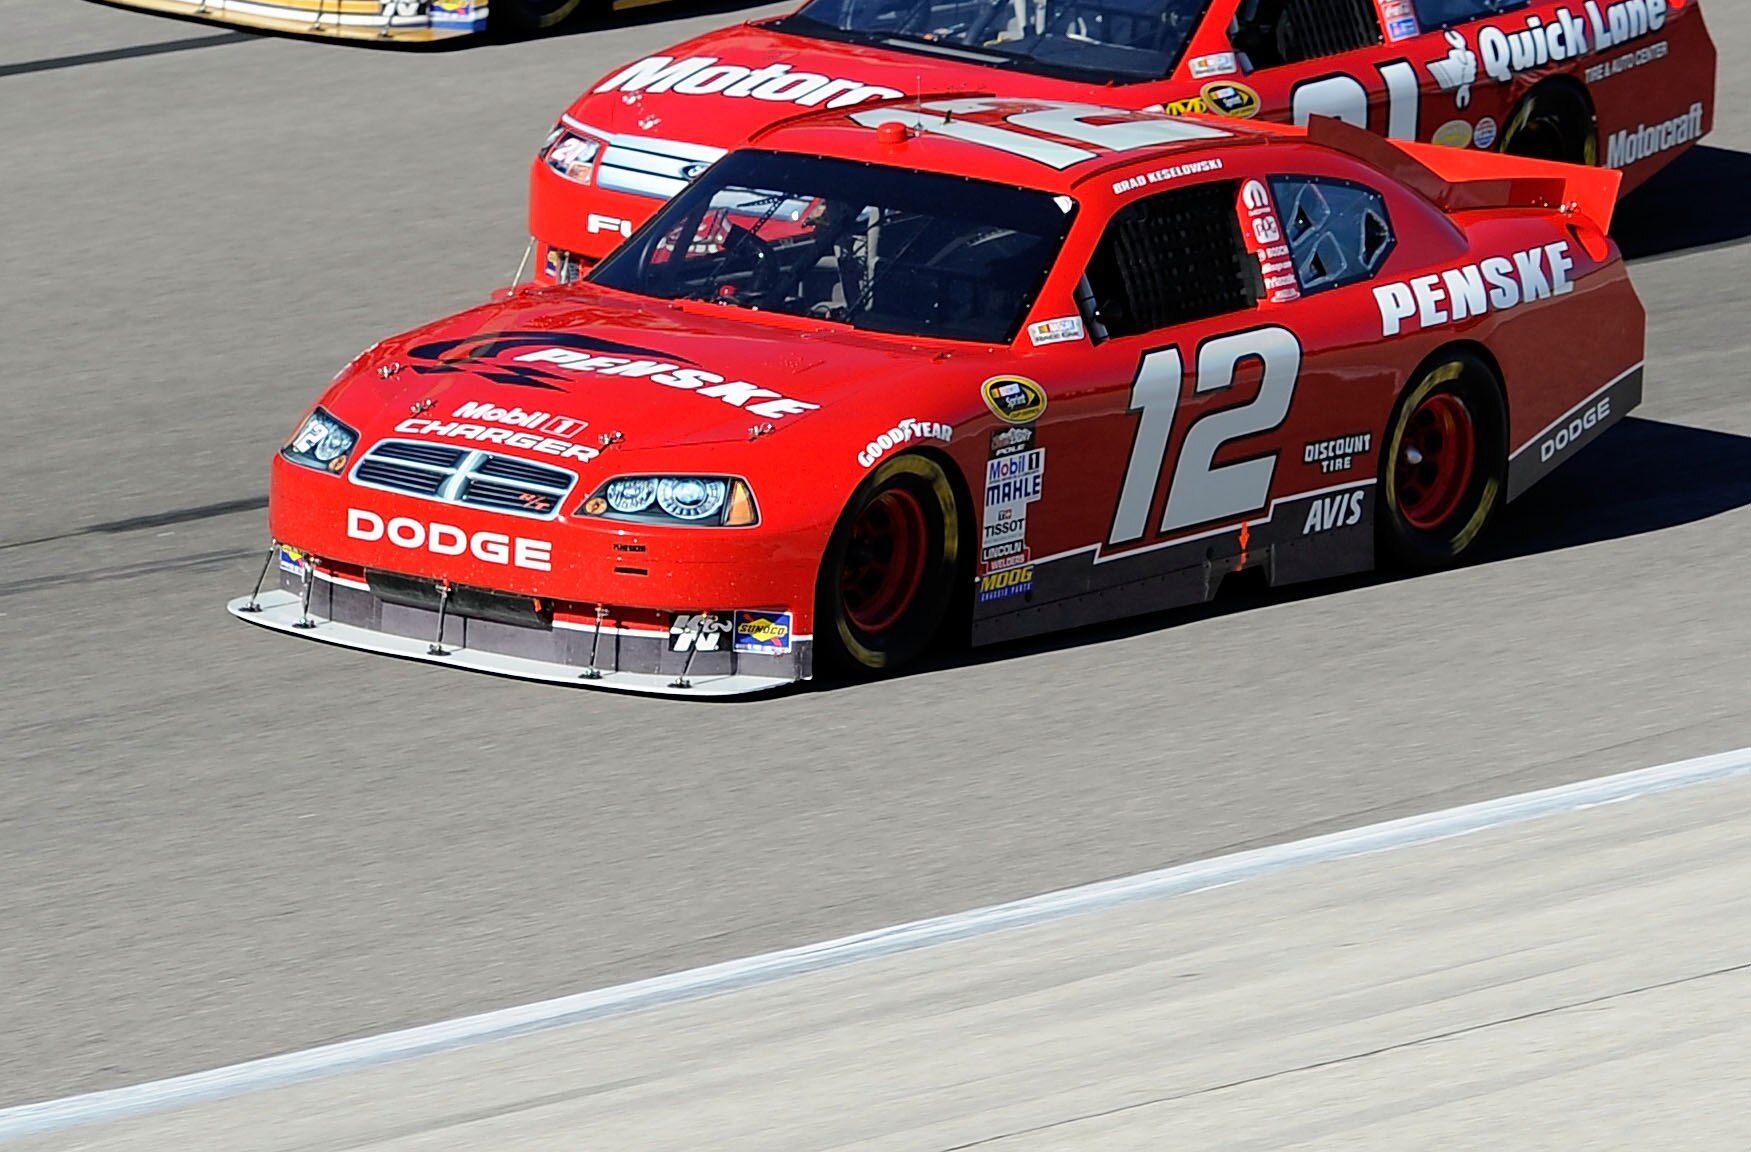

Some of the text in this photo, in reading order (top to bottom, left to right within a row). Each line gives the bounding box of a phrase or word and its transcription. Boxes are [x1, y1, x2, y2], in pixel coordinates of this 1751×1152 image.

[1478, 5, 1588, 83] Quick
[1605, 102, 1703, 168] Motorcraft
[1112, 158, 1223, 195] BRAD KESELOWSKI
[1372, 241, 1574, 336] PENSKE
[513, 347, 823, 420] PENSKE
[452, 401, 549, 430] Mobil
[1541, 398, 1611, 462] DODGE
[394, 418, 600, 464] CHARGER
[857, 418, 954, 468] GOODYEAR
[1109, 327, 1301, 545] 12
[1304, 434, 1371, 462] DISCOUNT
[990, 454, 1026, 480] Mobil
[1322, 457, 1351, 473] TIRE
[986, 475, 1040, 506] MAHLE
[984, 519, 1024, 538] TISSOT
[1303, 491, 1365, 534] AVIS
[347, 508, 552, 571] DODGE
[984, 541, 1023, 560] LINCOLN
[981, 568, 1033, 592] MOOG
[739, 624, 787, 636] SUNOCO
